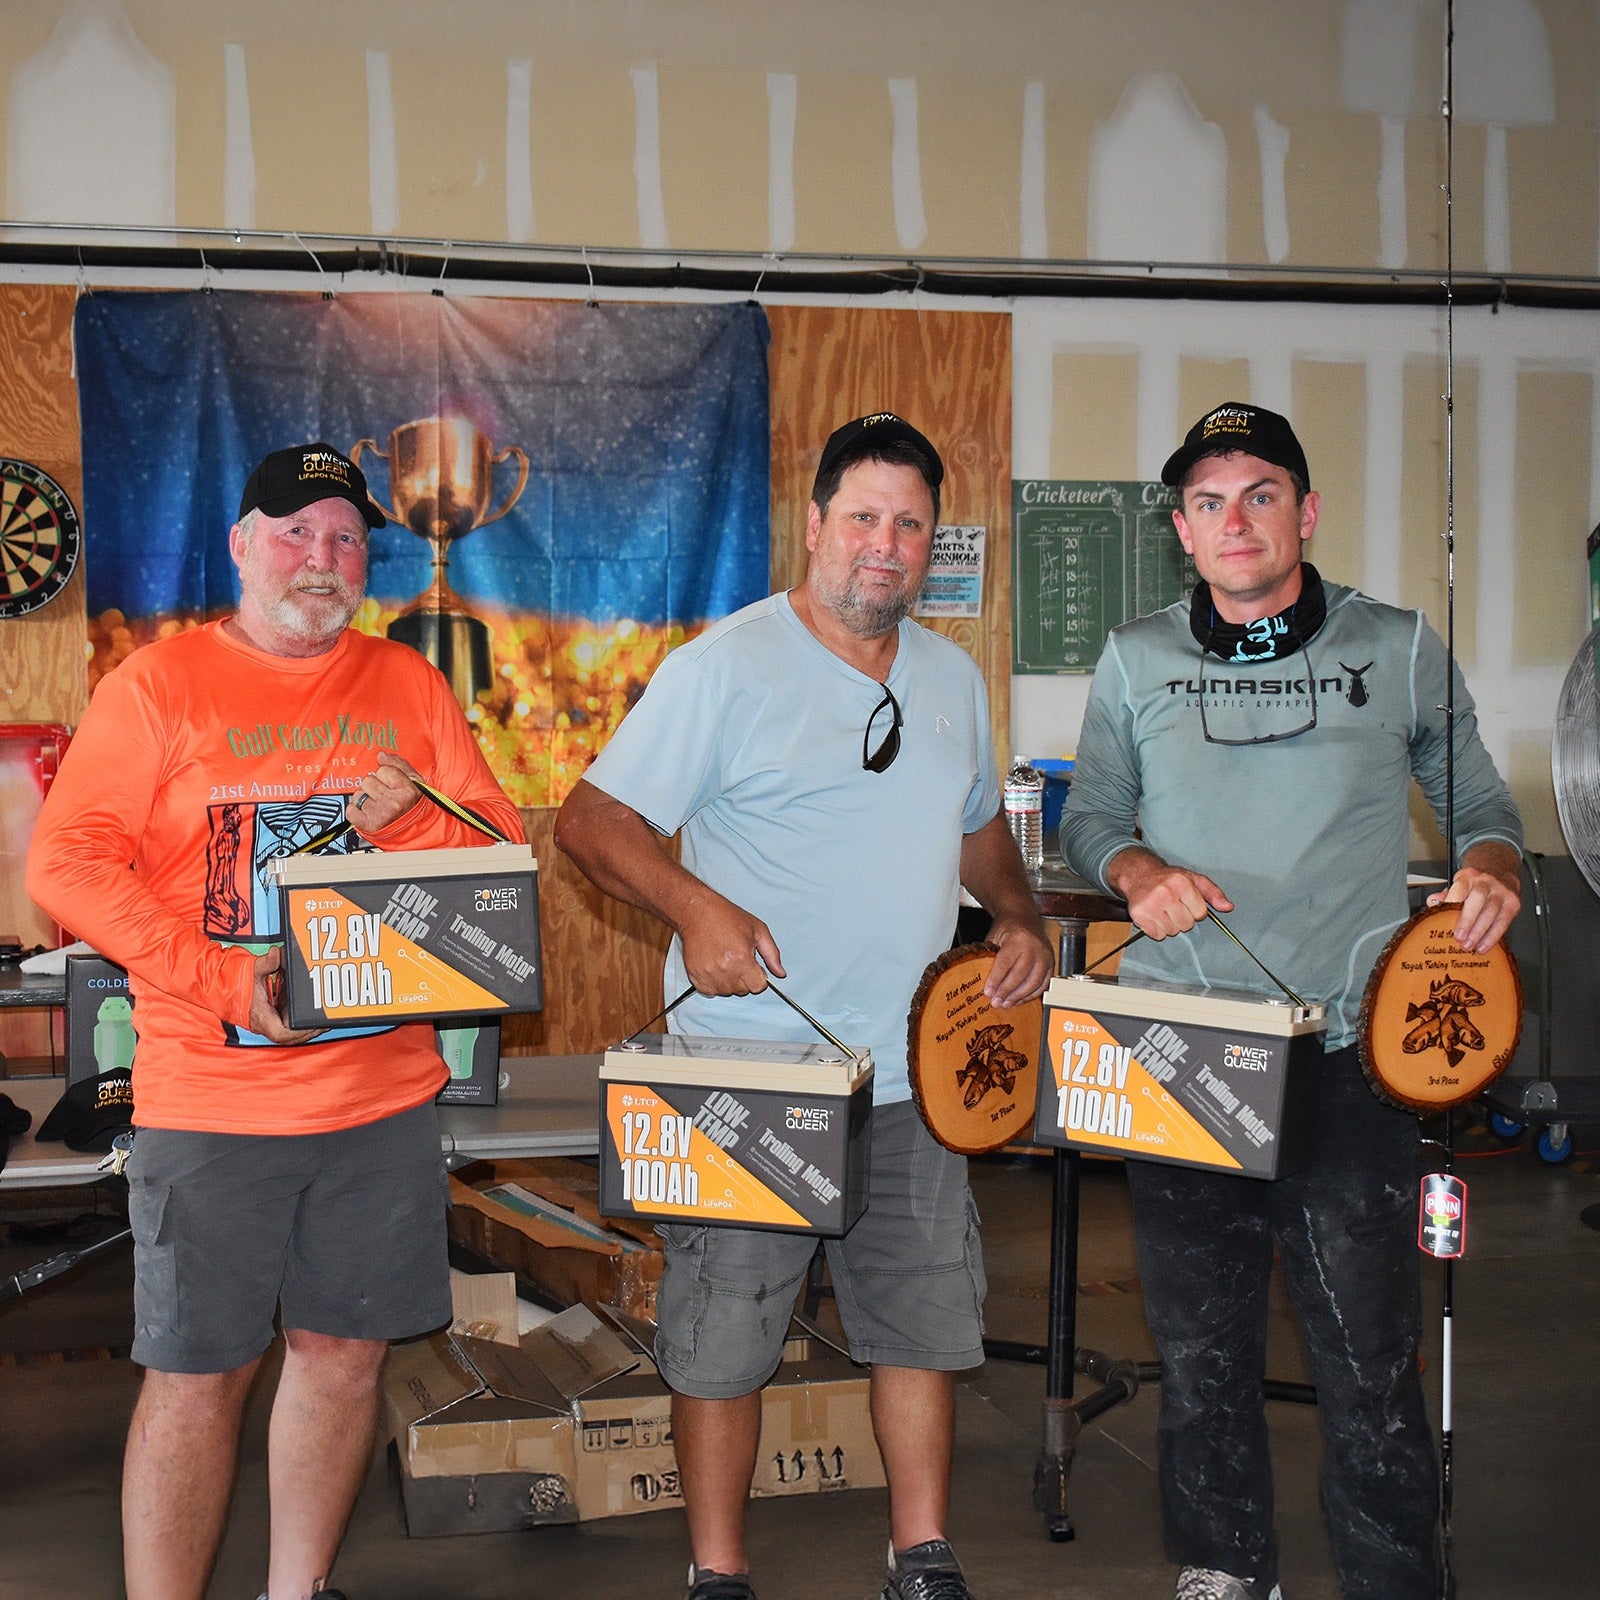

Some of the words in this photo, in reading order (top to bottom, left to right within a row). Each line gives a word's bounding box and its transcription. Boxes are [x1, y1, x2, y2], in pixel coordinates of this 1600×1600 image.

[1022, 482, 1105, 504] Cricketeer
[1064, 538, 1078, 549] 20
[931, 552, 980, 561] ORNHOLE
[1066, 554, 1077, 565] 19
[1066, 571, 1077, 582] 18
[1066, 587, 1077, 598] 17
[1066, 603, 1077, 614] 16
[1066, 620, 1078, 631] 15
[227, 724, 278, 759] Gulf
[278, 720, 335, 752] Coast
[338, 714, 399, 751] Kayak
[286, 757, 357, 774] Presnts
[249, 780, 307, 797] Annual
[391, 883, 439, 920] LOW-
[474, 888, 517, 900] POWER
[318, 900, 343, 909] LTCP
[475, 899, 518, 911] QUEEN
[306, 913, 381, 961] 12.8V
[450, 913, 497, 958] Trolling
[494, 943, 536, 979] Motor
[1401, 961, 1423, 972] Kayak
[1425, 960, 1449, 971] Fishing
[1450, 960, 1490, 968] Tournament
[87, 978, 130, 988] COLDE
[309, 961, 393, 1009] 100Ah
[1075, 1024, 1099, 1035] LTCP
[1144, 1022, 1190, 1064] LOW-
[1224, 1043, 1268, 1060] POWER
[1061, 1037, 1132, 1090] 12.8V
[1223, 1055, 1267, 1073] QUEEN
[98, 1079, 132, 1092] POWE
[99, 1088, 133, 1100] QUEE
[634, 1097, 659, 1107] LTCP
[703, 1091, 751, 1129] LOW-
[1056, 1085, 1133, 1139] 100Ah
[1195, 1063, 1241, 1115] Trolling
[1235, 1104, 1275, 1146] Motor
[785, 1106, 829, 1120] POWER
[785, 1117, 829, 1131] QUEEN
[621, 1111, 693, 1159] 12.8V
[758, 1127, 805, 1175] Trolling
[800, 1164, 841, 1201] Motor
[620, 1158, 699, 1206] 100Ah
[1427, 1198, 1458, 1214] PNN
